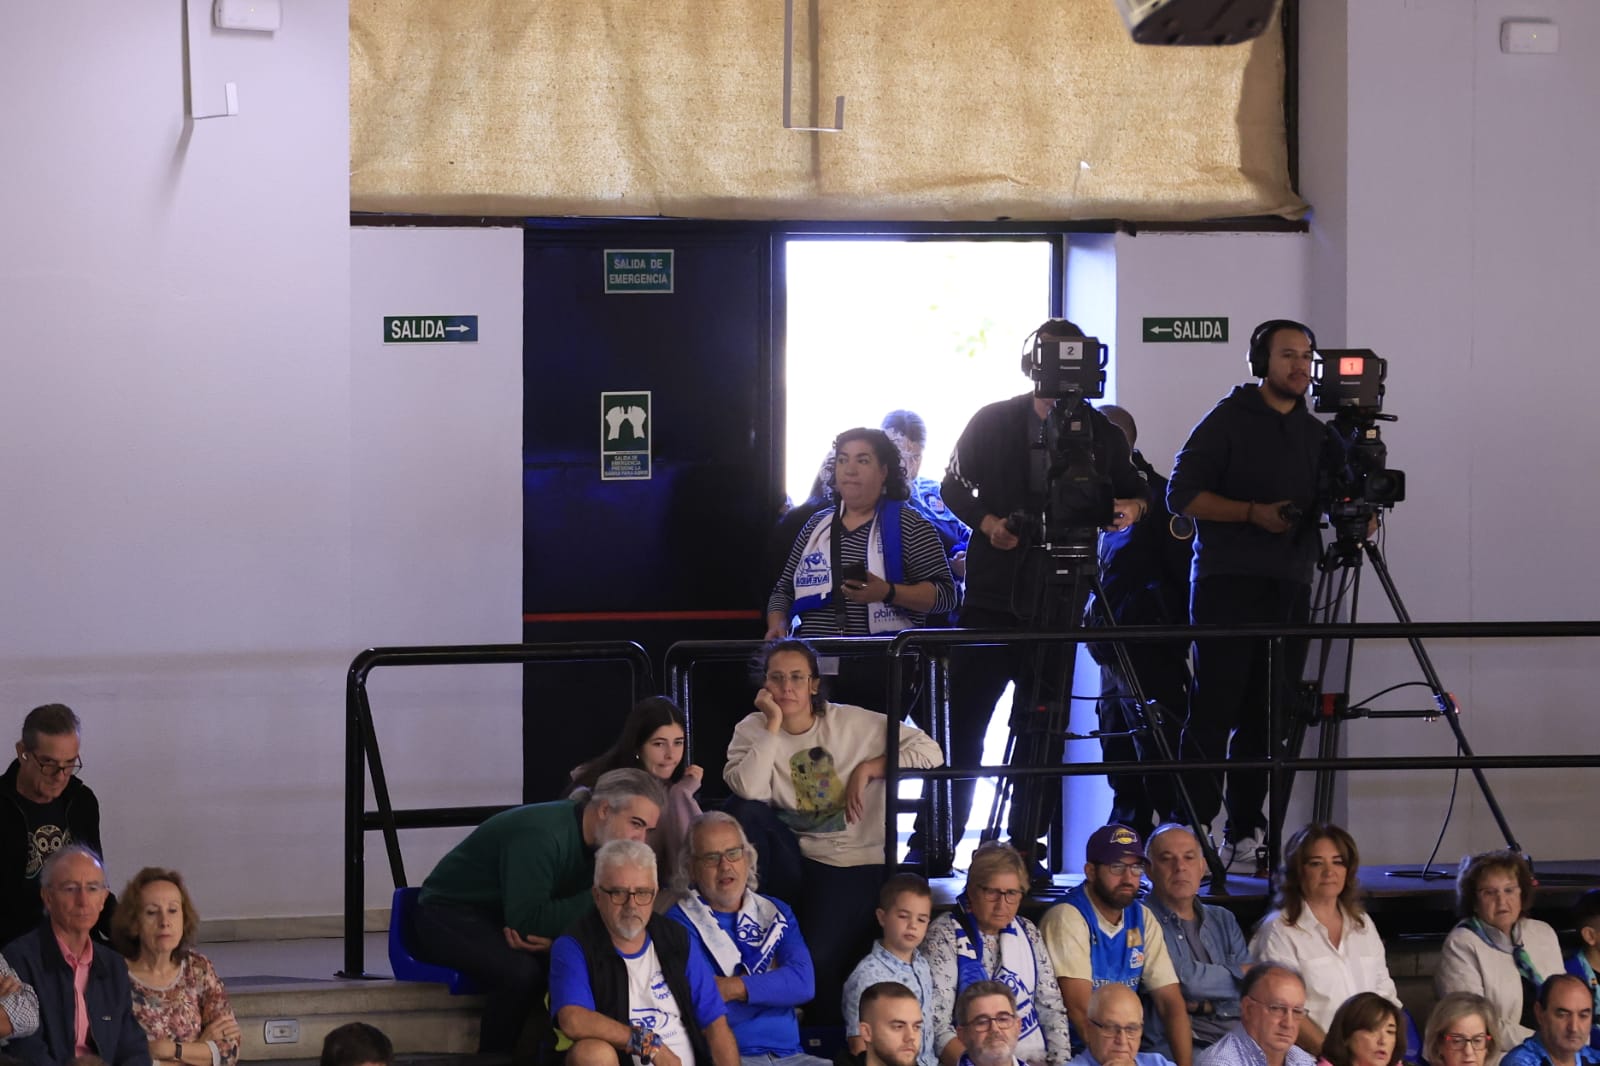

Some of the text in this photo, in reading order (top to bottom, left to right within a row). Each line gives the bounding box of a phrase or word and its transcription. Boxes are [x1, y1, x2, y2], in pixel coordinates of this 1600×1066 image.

[613, 258, 664, 269] SALIDA DE
[609, 273, 669, 285] EMERGENCIA
[391, 319, 446, 339] SALIDA
[1173, 320, 1223, 339] SALIDA
[1067, 346, 1075, 356] 2
